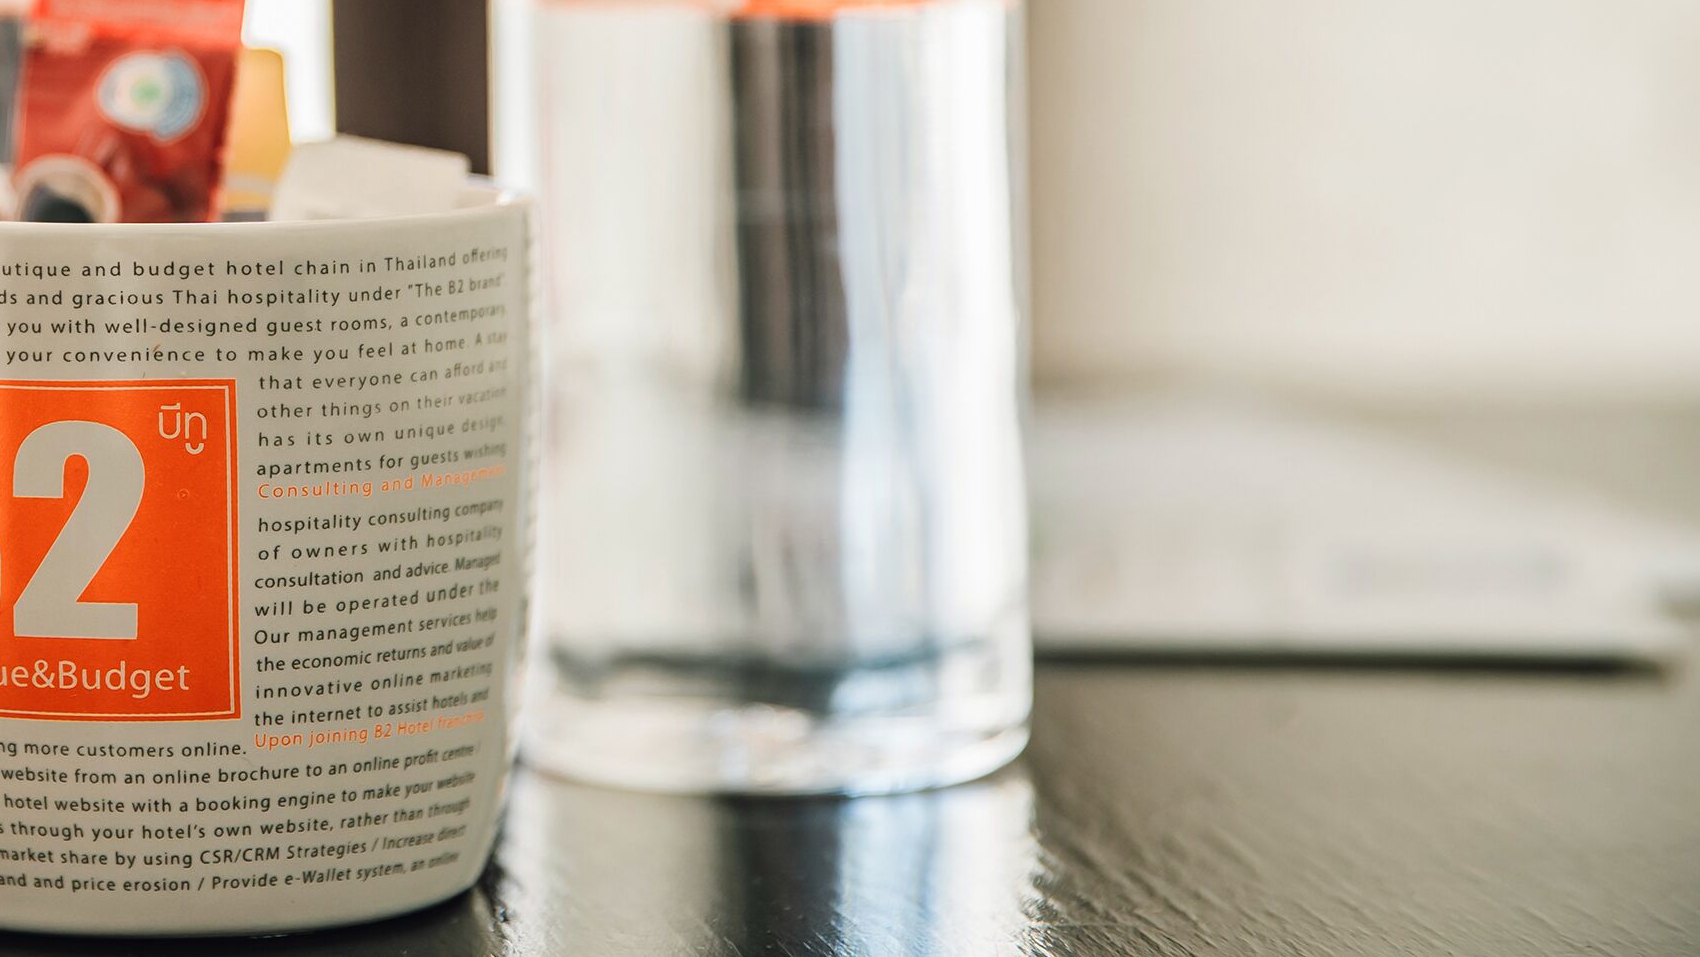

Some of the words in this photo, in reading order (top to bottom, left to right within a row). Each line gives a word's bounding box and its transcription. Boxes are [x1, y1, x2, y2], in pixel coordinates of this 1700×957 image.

[82, 261, 121, 277] and
[133, 261, 214, 280] budget
[227, 260, 283, 276] hotel
[294, 260, 349, 275] chain
[360, 259, 376, 273] in
[384, 252, 456, 271] Thailand
[26, 290, 62, 305] and
[72, 291, 163, 309] gracious
[172, 290, 217, 304] Thai
[228, 289, 340, 307] hospitality
[349, 286, 401, 302] under
[408, 283, 442, 298] "The
[448, 279, 463, 295] B2
[7, 322, 41, 337] you
[51, 319, 95, 334] with
[105, 318, 257, 337] well-designed
[266, 319, 322, 337] guest
[331, 318, 392, 331] rooms,
[400, 316, 408, 327] a
[6, 351, 52, 365] your
[63, 347, 205, 362] convenience
[216, 348, 237, 361] to
[248, 346, 303, 361] make
[313, 349, 348, 364] you
[358, 342, 392, 358] feel
[401, 342, 416, 355] at
[259, 375, 302, 390] that
[312, 373, 402, 391] everyone
[410, 370, 438, 382] can
[445, 362, 484, 379] afford
[257, 403, 312, 418] other
[322, 402, 381, 419] things
[389, 400, 409, 412] on
[417, 396, 453, 409] their
[259, 432, 295, 447] has
[307, 432, 333, 446] its
[344, 431, 384, 444] own
[395, 424, 454, 440] unique
[257, 459, 371, 479] apartments
[379, 454, 403, 469] for
[410, 450, 459, 470] guests
[258, 482, 372, 498] Consulting
[381, 477, 413, 491] and
[258, 514, 361, 535] hospitality
[368, 507, 450, 526] consulting
[258, 545, 281, 560] of
[291, 544, 367, 559] owners
[378, 535, 418, 553] with
[254, 570, 363, 589] consultation
[373, 564, 401, 581] and
[255, 601, 292, 617] will
[303, 600, 326, 614] be
[336, 590, 419, 614] operated
[426, 584, 474, 603] under
[254, 630, 290, 645] Our
[298, 619, 413, 642] management
[419, 614, 471, 631] services
[256, 656, 285, 672] the
[291, 651, 372, 670] economic
[377, 647, 427, 662] returns
[430, 640, 453, 657] and
[256, 680, 362, 699] innovative
[371, 674, 423, 690] online
[254, 712, 284, 727] the
[292, 706, 361, 724] internet
[368, 705, 383, 718] to
[388, 699, 428, 716] assist
[24, 743, 69, 756] more
[76, 744, 174, 757] customers
[181, 742, 246, 757] online.
[255, 734, 302, 751] Upon
[308, 729, 368, 748] joining
[374, 723, 391, 738] B2
[1, 767, 68, 783] website
[74, 768, 116, 784] from
[124, 774, 145, 784] an
[152, 770, 211, 784] online
[218, 766, 299, 783] brochure
[306, 765, 322, 777] to
[328, 763, 347, 775] an
[353, 757, 400, 773] online
[403, 749, 438, 770] profit
[4, 793, 48, 810] hotel
[54, 797, 125, 813] website
[132, 798, 171, 813] with
[179, 801, 188, 812] a
[196, 796, 270, 812] booking
[277, 791, 336, 810] engine
[342, 790, 357, 802] to
[363, 784, 400, 800] make
[405, 781, 434, 799] your
[10, 821, 84, 841] through
[92, 828, 134, 842] your
[214, 825, 252, 837] own
[260, 819, 333, 834] website,
[340, 812, 388, 829] rather
[393, 809, 423, 823] than
[60, 850, 108, 865] share
[115, 851, 136, 869] by
[143, 852, 192, 869] using
[200, 847, 280, 864] CSR/CRM
[286, 842, 366, 859] Strategies
[33, 875, 64, 889] and
[71, 878, 116, 893] price
[123, 878, 190, 892] erosion
[212, 873, 278, 890] Provide
[284, 868, 352, 885] e-Wallet
